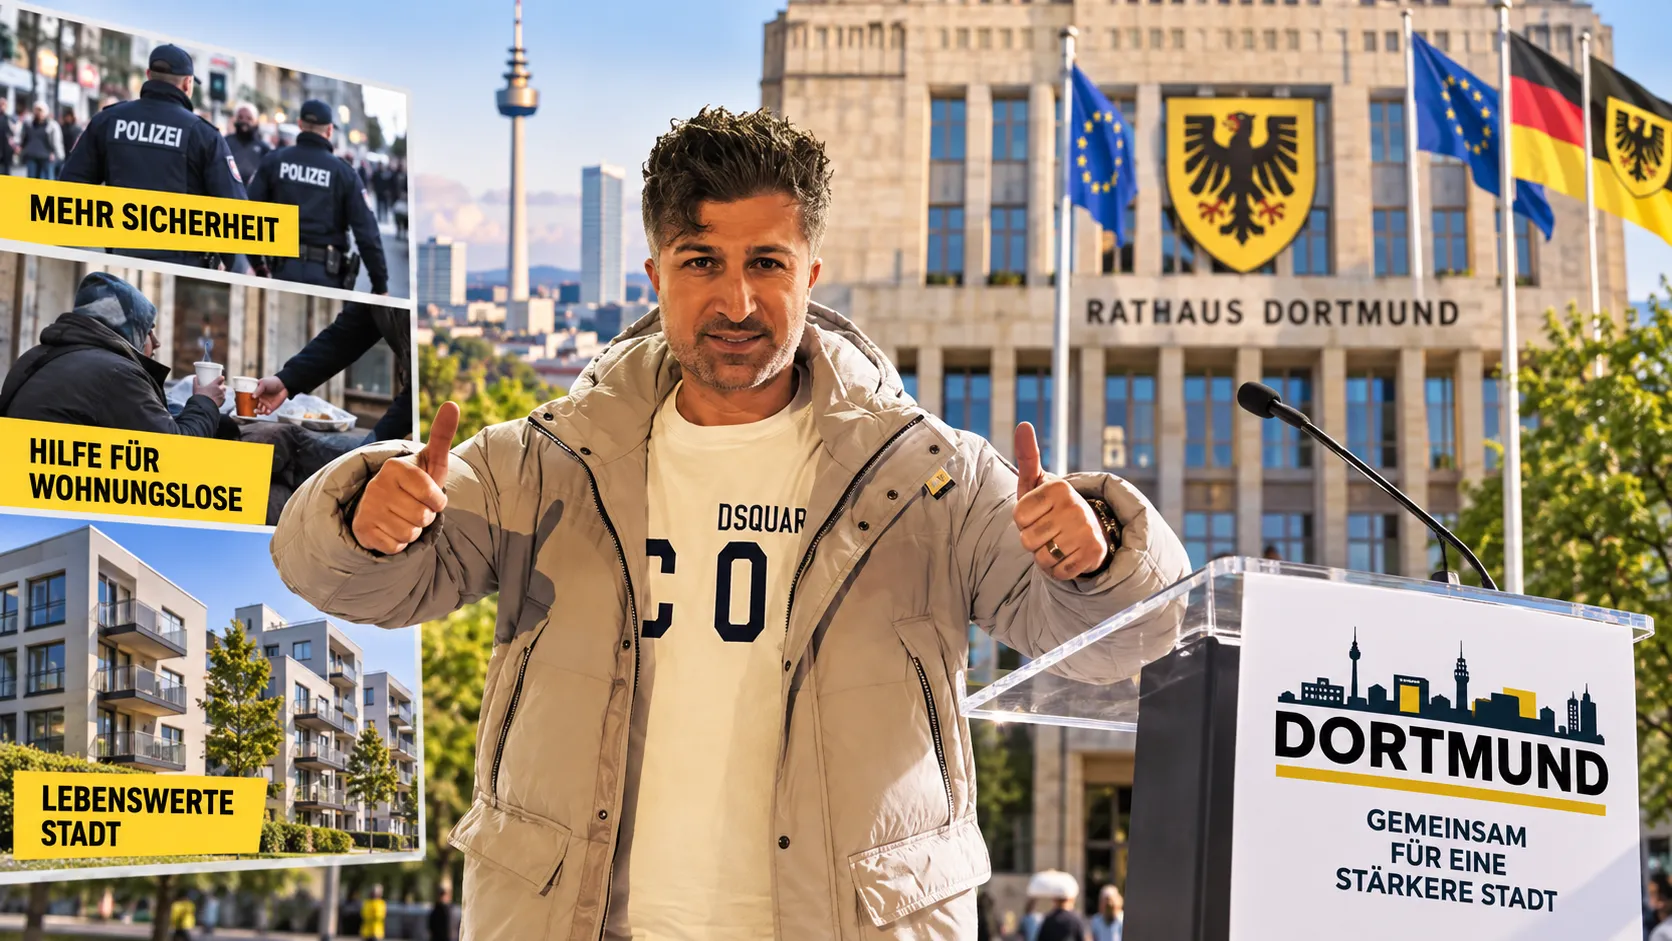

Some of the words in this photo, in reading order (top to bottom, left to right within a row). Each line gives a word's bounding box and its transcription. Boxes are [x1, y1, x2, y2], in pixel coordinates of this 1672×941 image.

[113, 119, 183, 148] POLIZEI
[279, 162, 331, 188] POLIZEI
[30, 194, 114, 229] MEHR
[121, 202, 280, 243] SICHERHEIT
[1087, 299, 1243, 325] RATHAUS
[1264, 300, 1460, 326] DORTMUND
[30, 438, 102, 469] HILFE
[110, 440, 160, 473] FÜR
[29, 473, 243, 512] WOHNUNGSLOSE
[1275, 710, 1609, 796] DORTMUND
[42, 785, 234, 816] LEBENSWERTE
[41, 820, 121, 847] STADT
[1366, 808, 1527, 848] GEMEINSAM
[1391, 838, 1442, 869] FÜR
[1449, 848, 1507, 876] EINE
[1335, 867, 1474, 904] STÄRKERE
[1481, 884, 1558, 912] STADT
